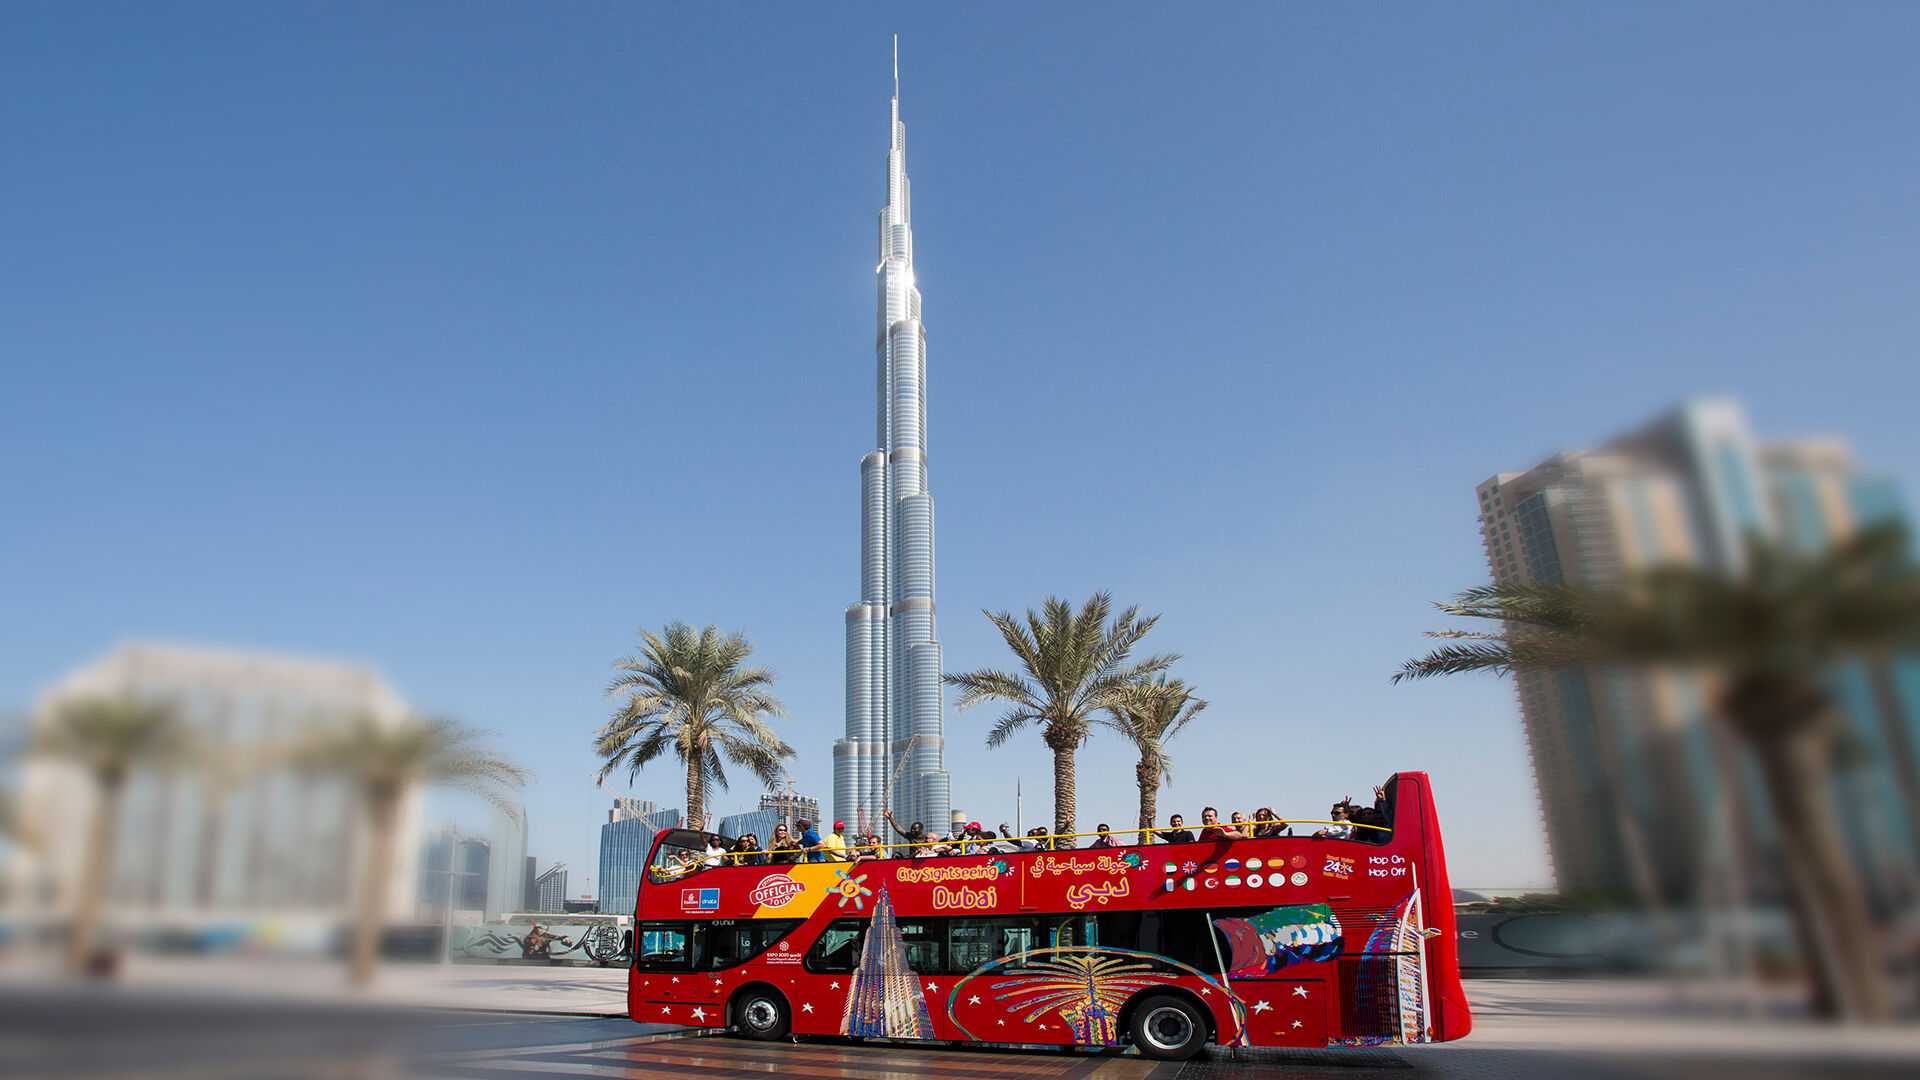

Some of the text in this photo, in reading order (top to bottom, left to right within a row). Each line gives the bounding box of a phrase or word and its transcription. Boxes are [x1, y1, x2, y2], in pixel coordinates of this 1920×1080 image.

[1030, 855, 1131, 878] جولة سياحية في
[1323, 860, 1341, 873] 24
[1368, 854, 1405, 866] Hop On
[897, 865, 998, 883] City Sightseeing
[1368, 867, 1406, 877] Hop Off
[755, 883, 802, 901] OFFICIAL
[770, 895, 791, 906] TOUR
[933, 886, 997, 909] Dubai
[1066, 877, 1130, 909] دبي
